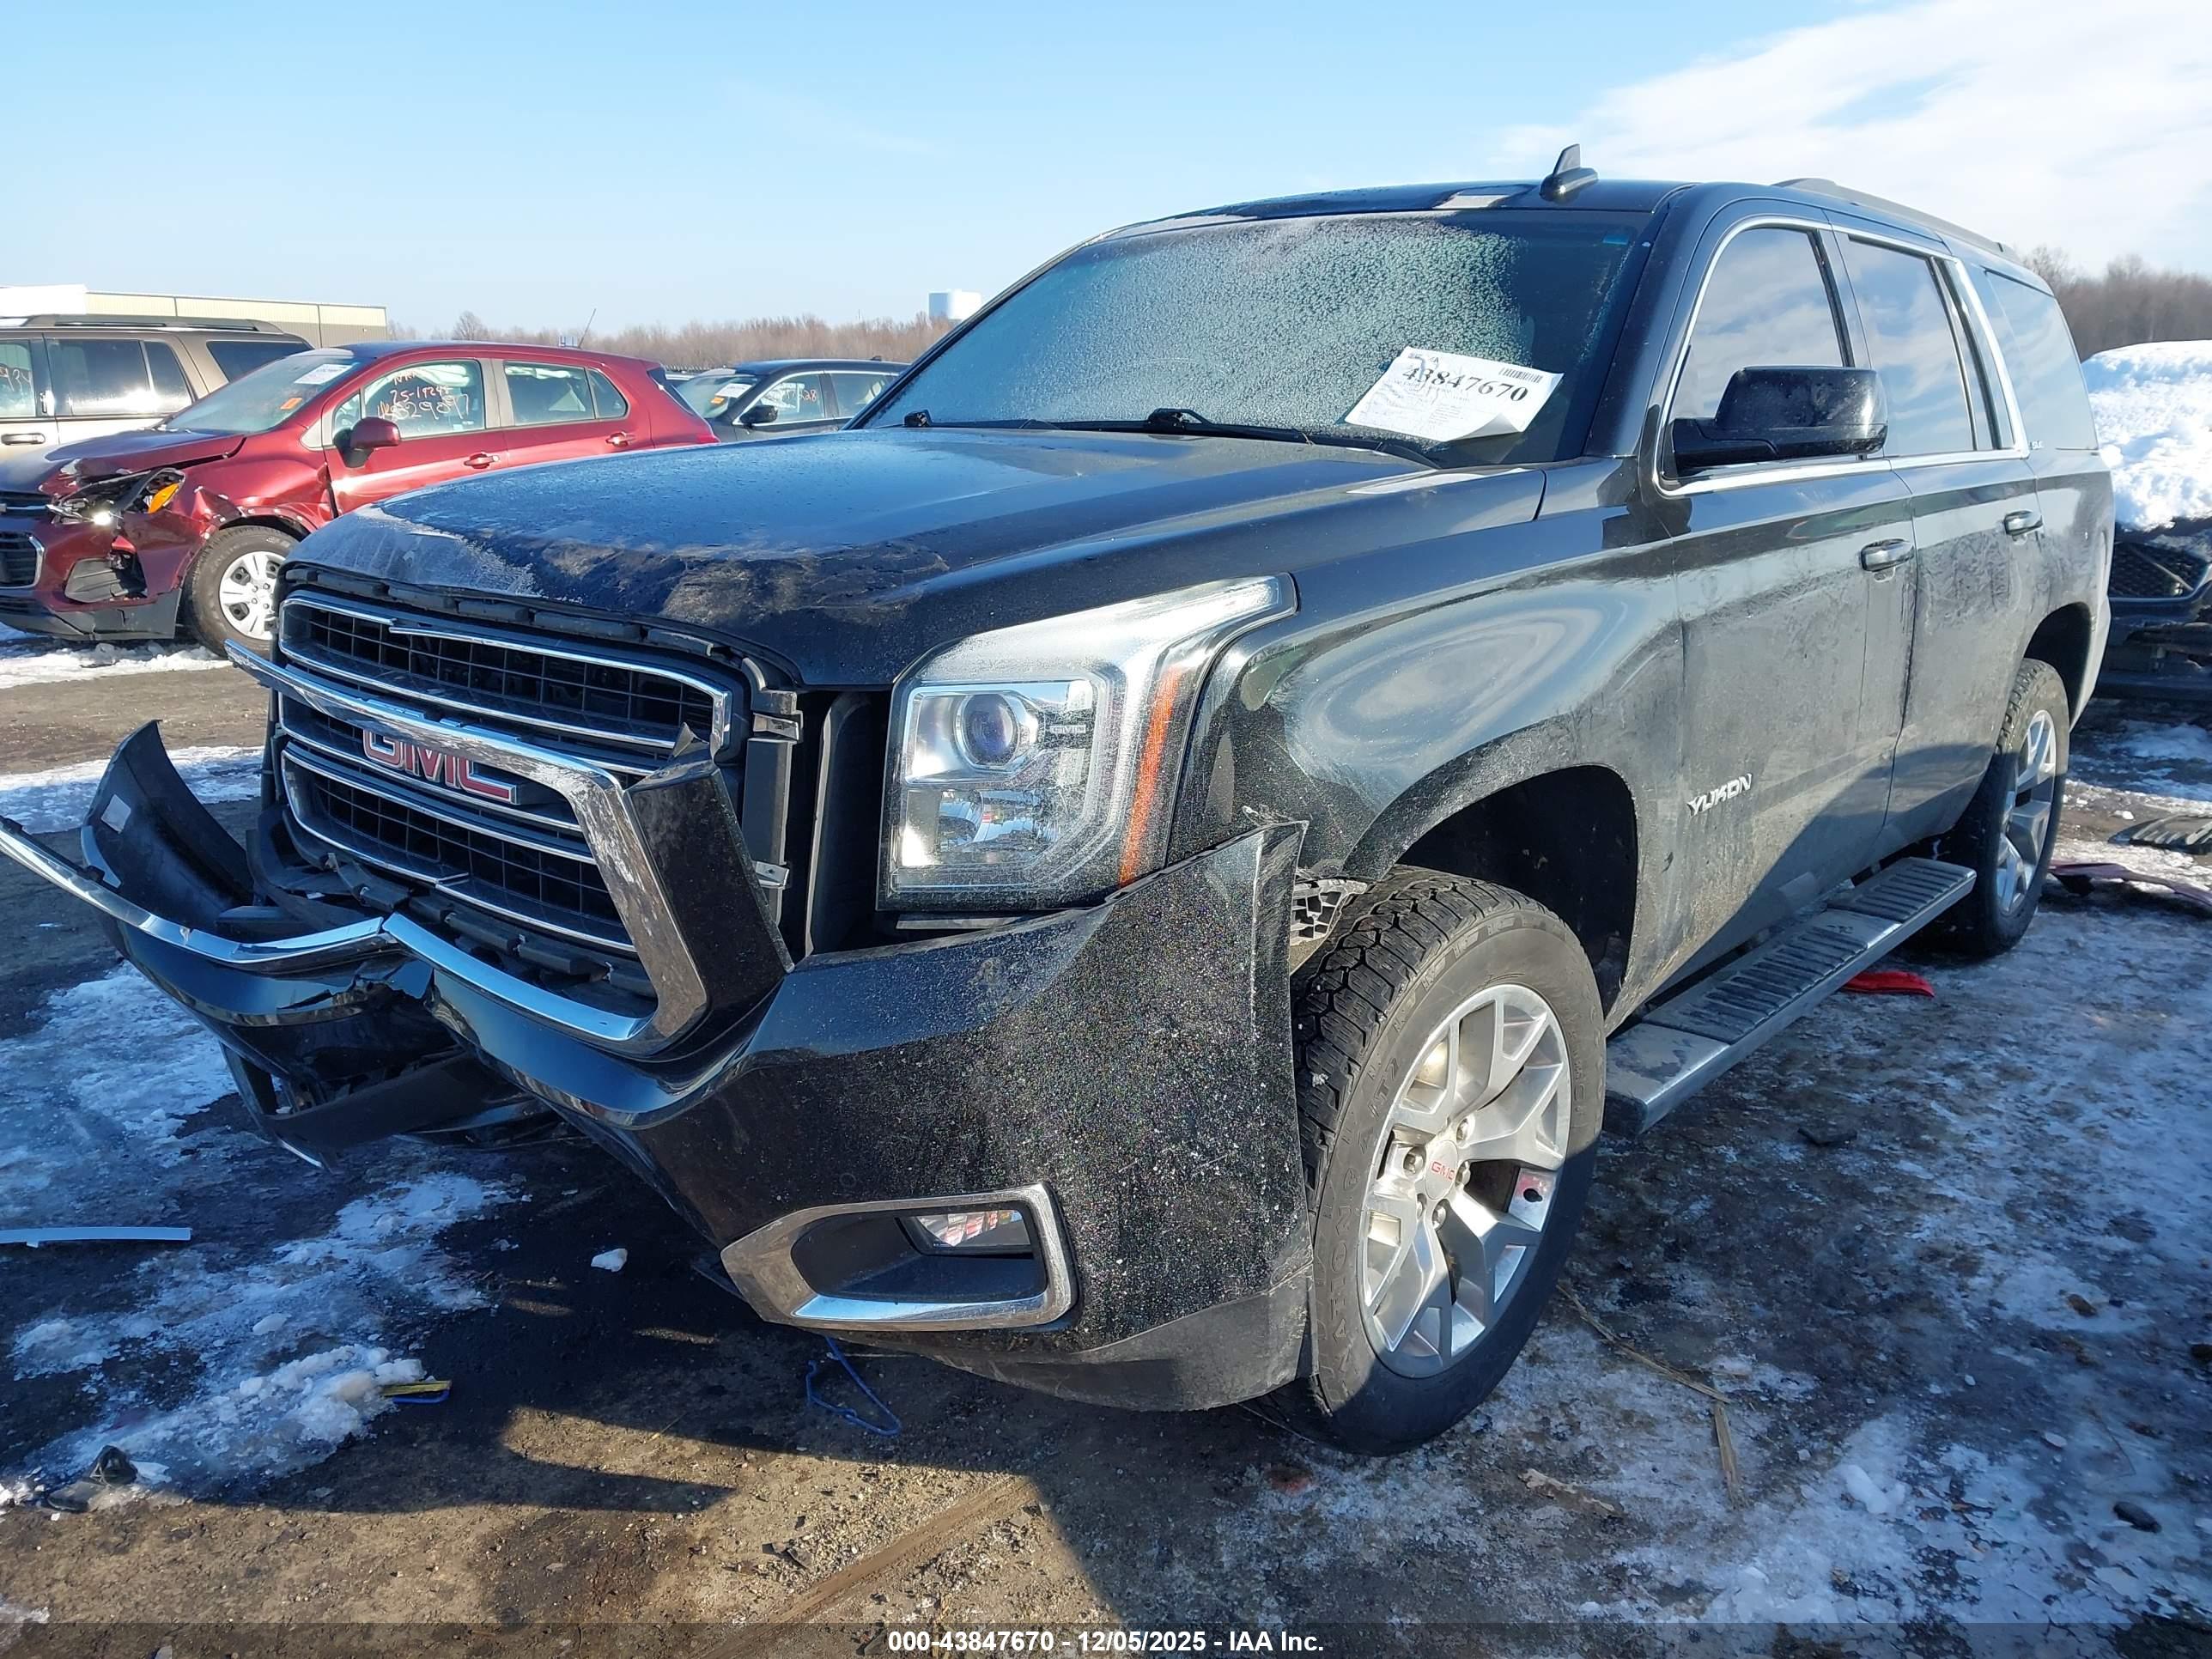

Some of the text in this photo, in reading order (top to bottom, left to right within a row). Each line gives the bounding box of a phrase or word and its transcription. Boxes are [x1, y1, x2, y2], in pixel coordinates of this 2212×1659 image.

[1402, 366, 1528, 402] 43847670
[1686, 773, 1753, 817] YUKON
[1431, 1161, 1455, 1181] GMC
